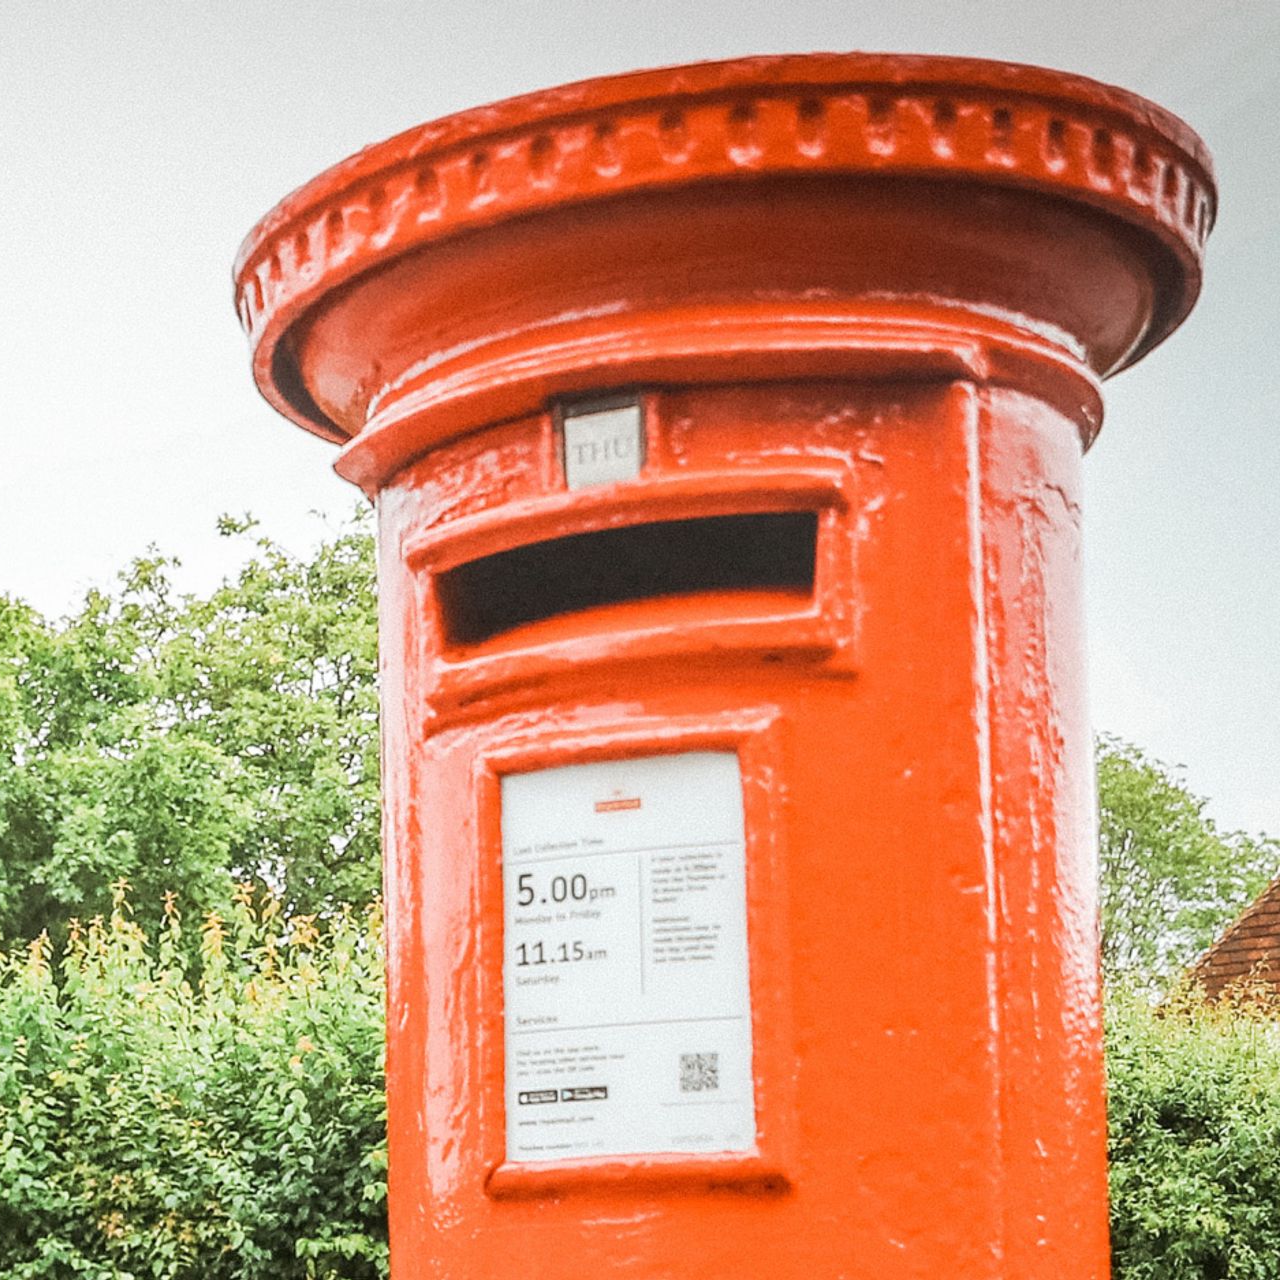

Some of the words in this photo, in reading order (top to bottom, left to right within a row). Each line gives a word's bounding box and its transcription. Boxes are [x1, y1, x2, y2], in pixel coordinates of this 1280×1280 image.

[572, 437, 632, 464] THU
[517, 873, 616, 907] 5.00pm
[514, 911, 552, 926] Monday
[569, 908, 602, 922] Friday
[515, 941, 608, 967] 11.15am
[516, 974, 560, 987] Saturday
